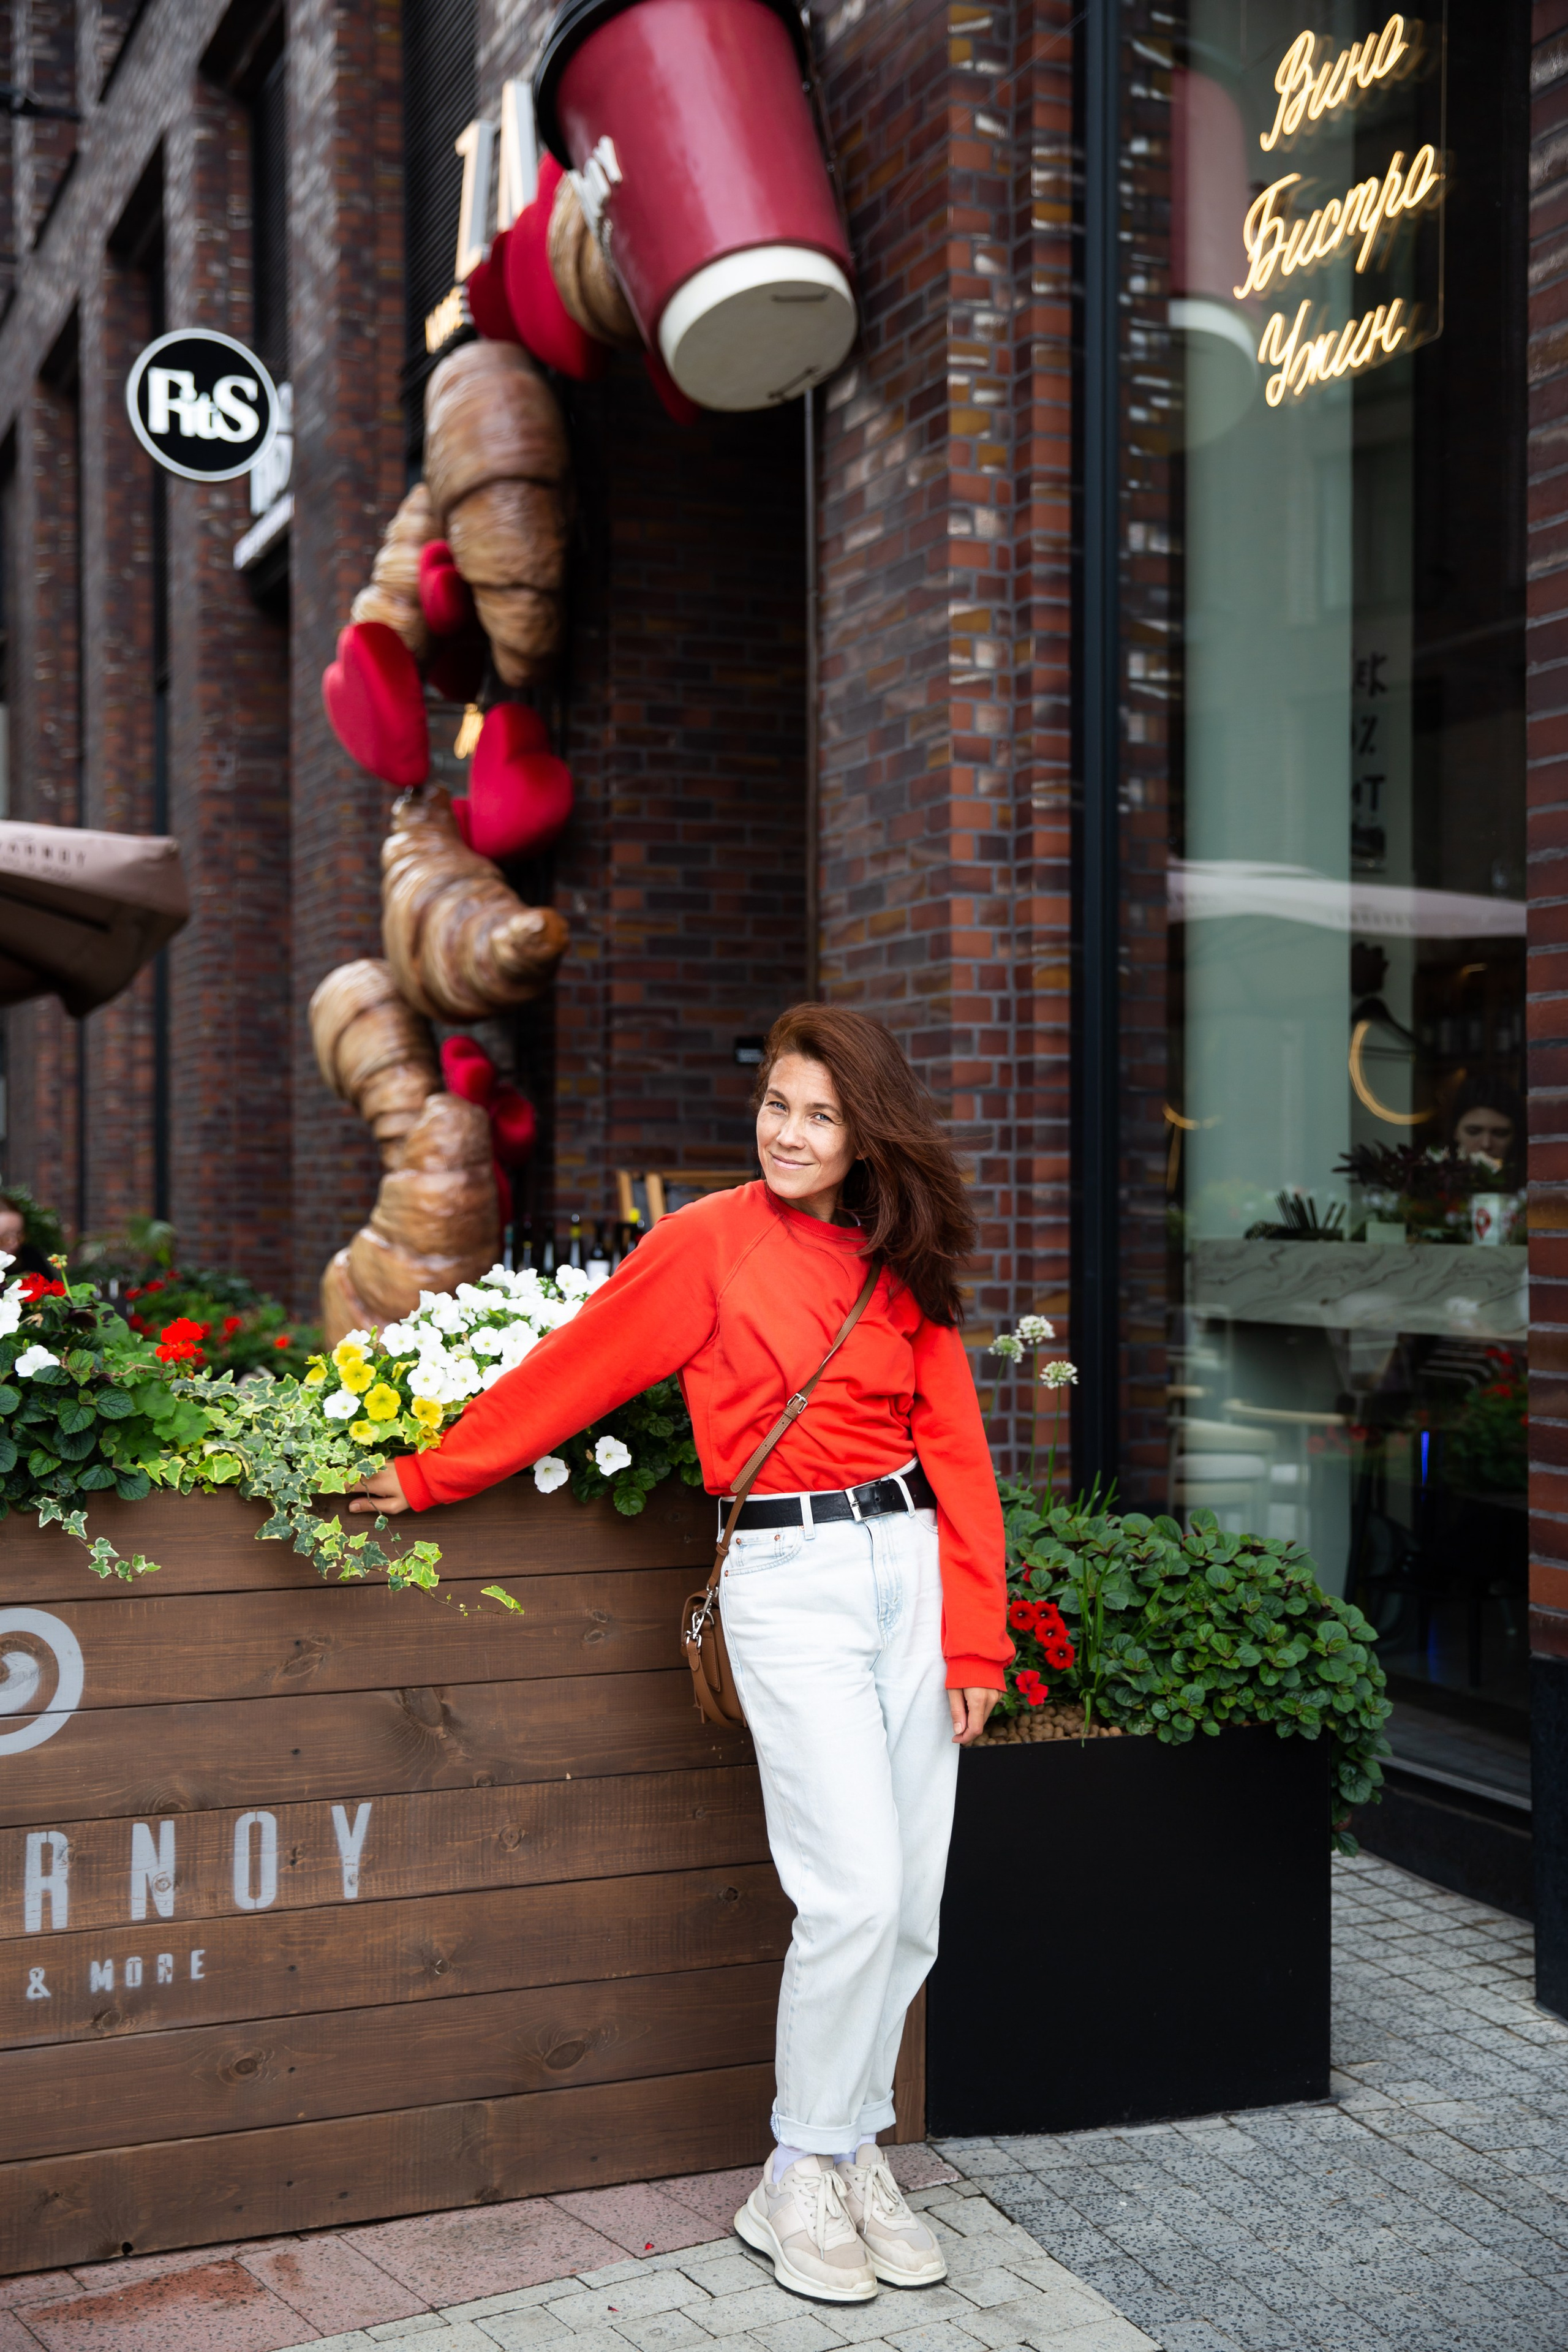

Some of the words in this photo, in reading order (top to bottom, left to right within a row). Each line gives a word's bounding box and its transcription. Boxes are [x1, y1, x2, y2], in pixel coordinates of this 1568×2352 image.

[1259, 13, 1409, 152] Вино
[1233, 143, 1441, 300] Бистро
[1257, 298, 1407, 407] Ужин
[24, 1803, 372, 1932] RNOY
[26, 1967, 51, 1999] &
[90, 1949, 205, 1992] MORE
